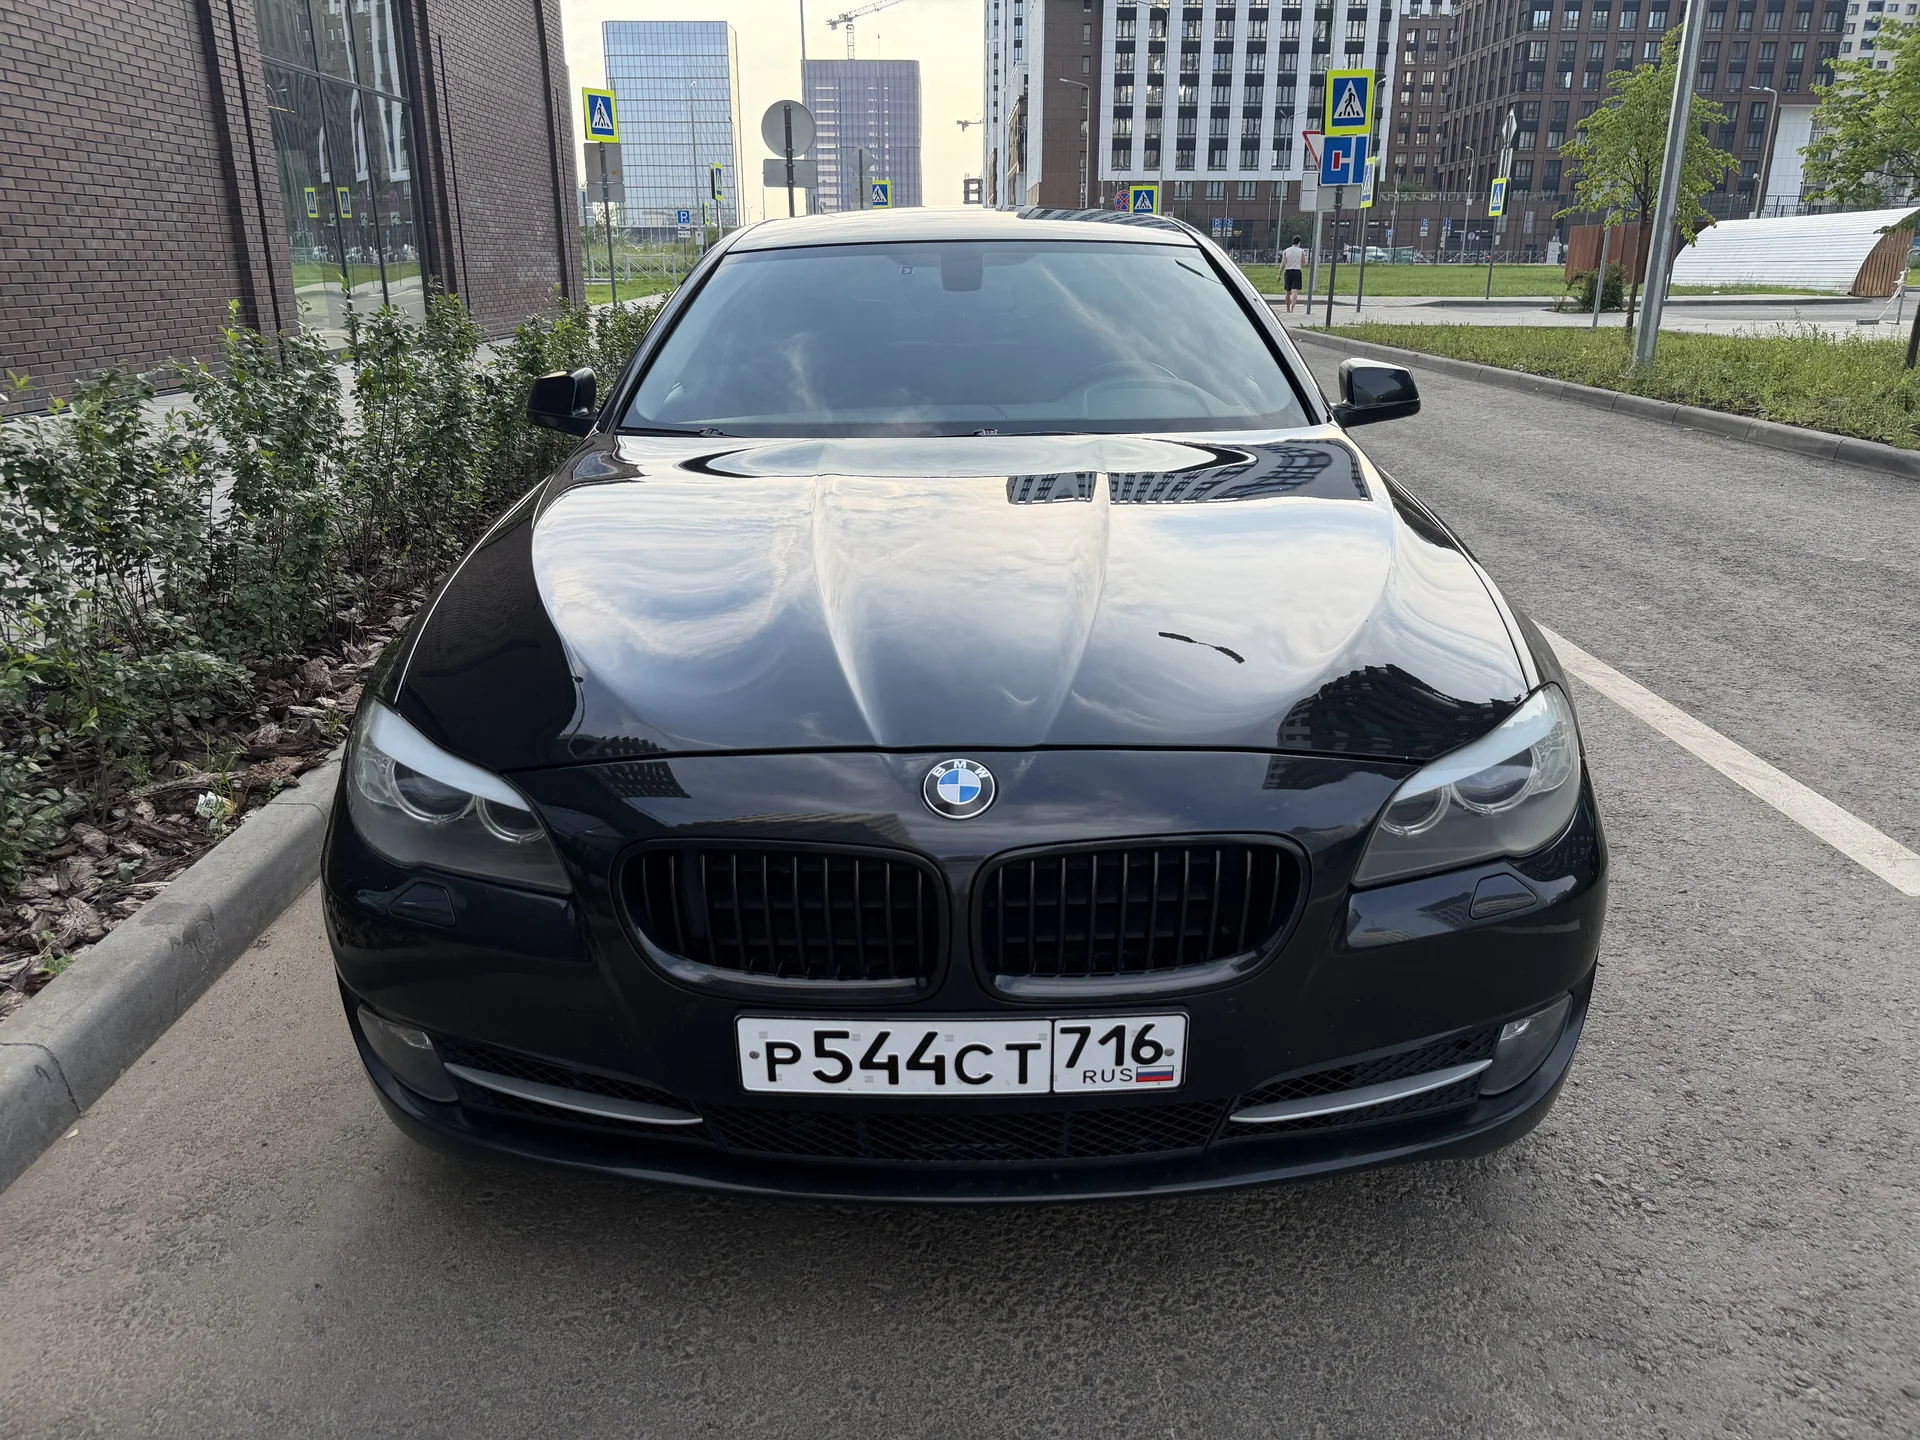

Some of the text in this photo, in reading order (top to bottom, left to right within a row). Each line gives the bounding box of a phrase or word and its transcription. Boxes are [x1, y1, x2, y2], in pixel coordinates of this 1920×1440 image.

[931, 760, 989, 778] BMW
[1060, 1023, 1164, 1068] 716
[1082, 1068, 1134, 1084] RUS
